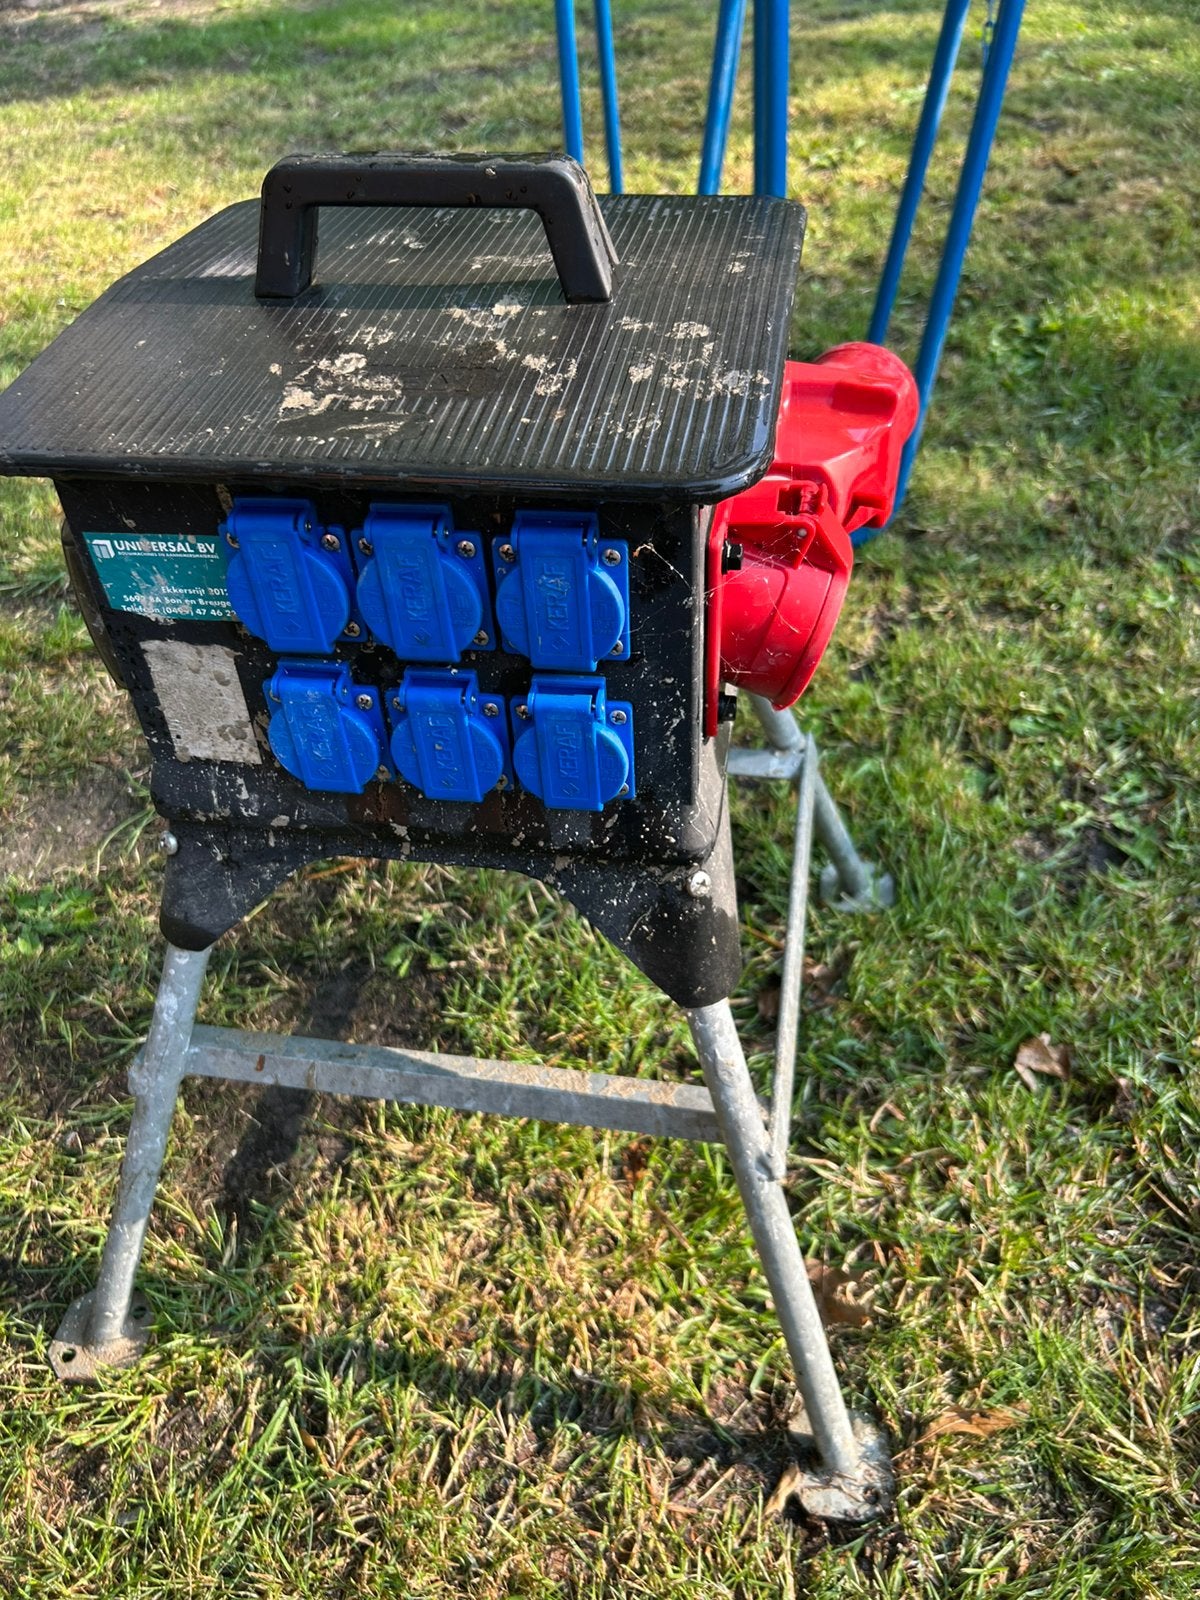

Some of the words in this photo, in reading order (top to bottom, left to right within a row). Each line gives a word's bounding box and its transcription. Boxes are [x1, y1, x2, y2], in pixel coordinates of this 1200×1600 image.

[196, 542, 215, 553] BV
[164, 597, 182, 605] Son
[184, 598, 197, 606] en
[198, 598, 232, 609] Breuge
[195, 608, 207, 616] 47
[210, 609, 223, 618] 46
[555, 724, 581, 778] KERAF
